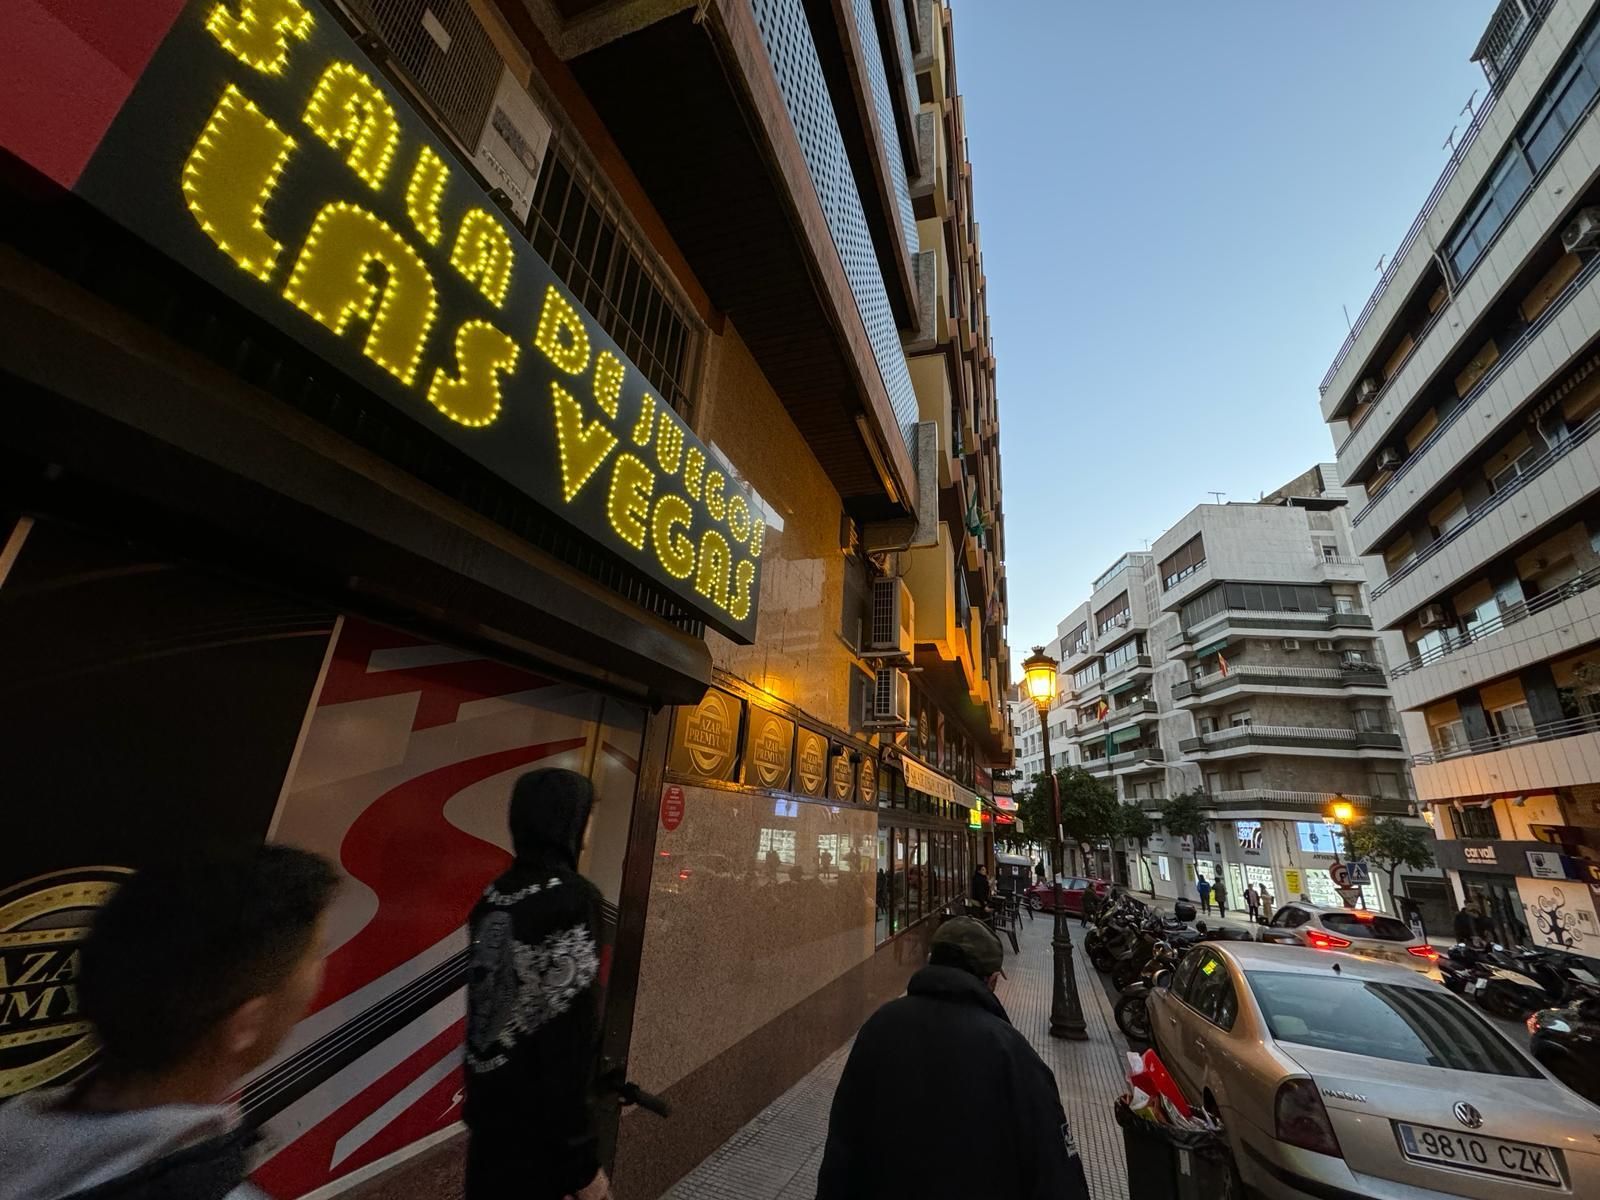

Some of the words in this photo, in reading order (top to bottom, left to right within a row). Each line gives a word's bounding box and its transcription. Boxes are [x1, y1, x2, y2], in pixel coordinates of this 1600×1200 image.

[180, 82, 522, 429] LAS
[551, 379, 757, 622] VEGAS
[204, 0, 514, 310] SALA
[533, 283, 627, 421] DE
[632, 391, 765, 559] JUEGOS
[700, 719, 721, 735] AZAR
[1421, 1131, 1488, 1165] 9810
[1497, 1145, 1551, 1176] CZK
